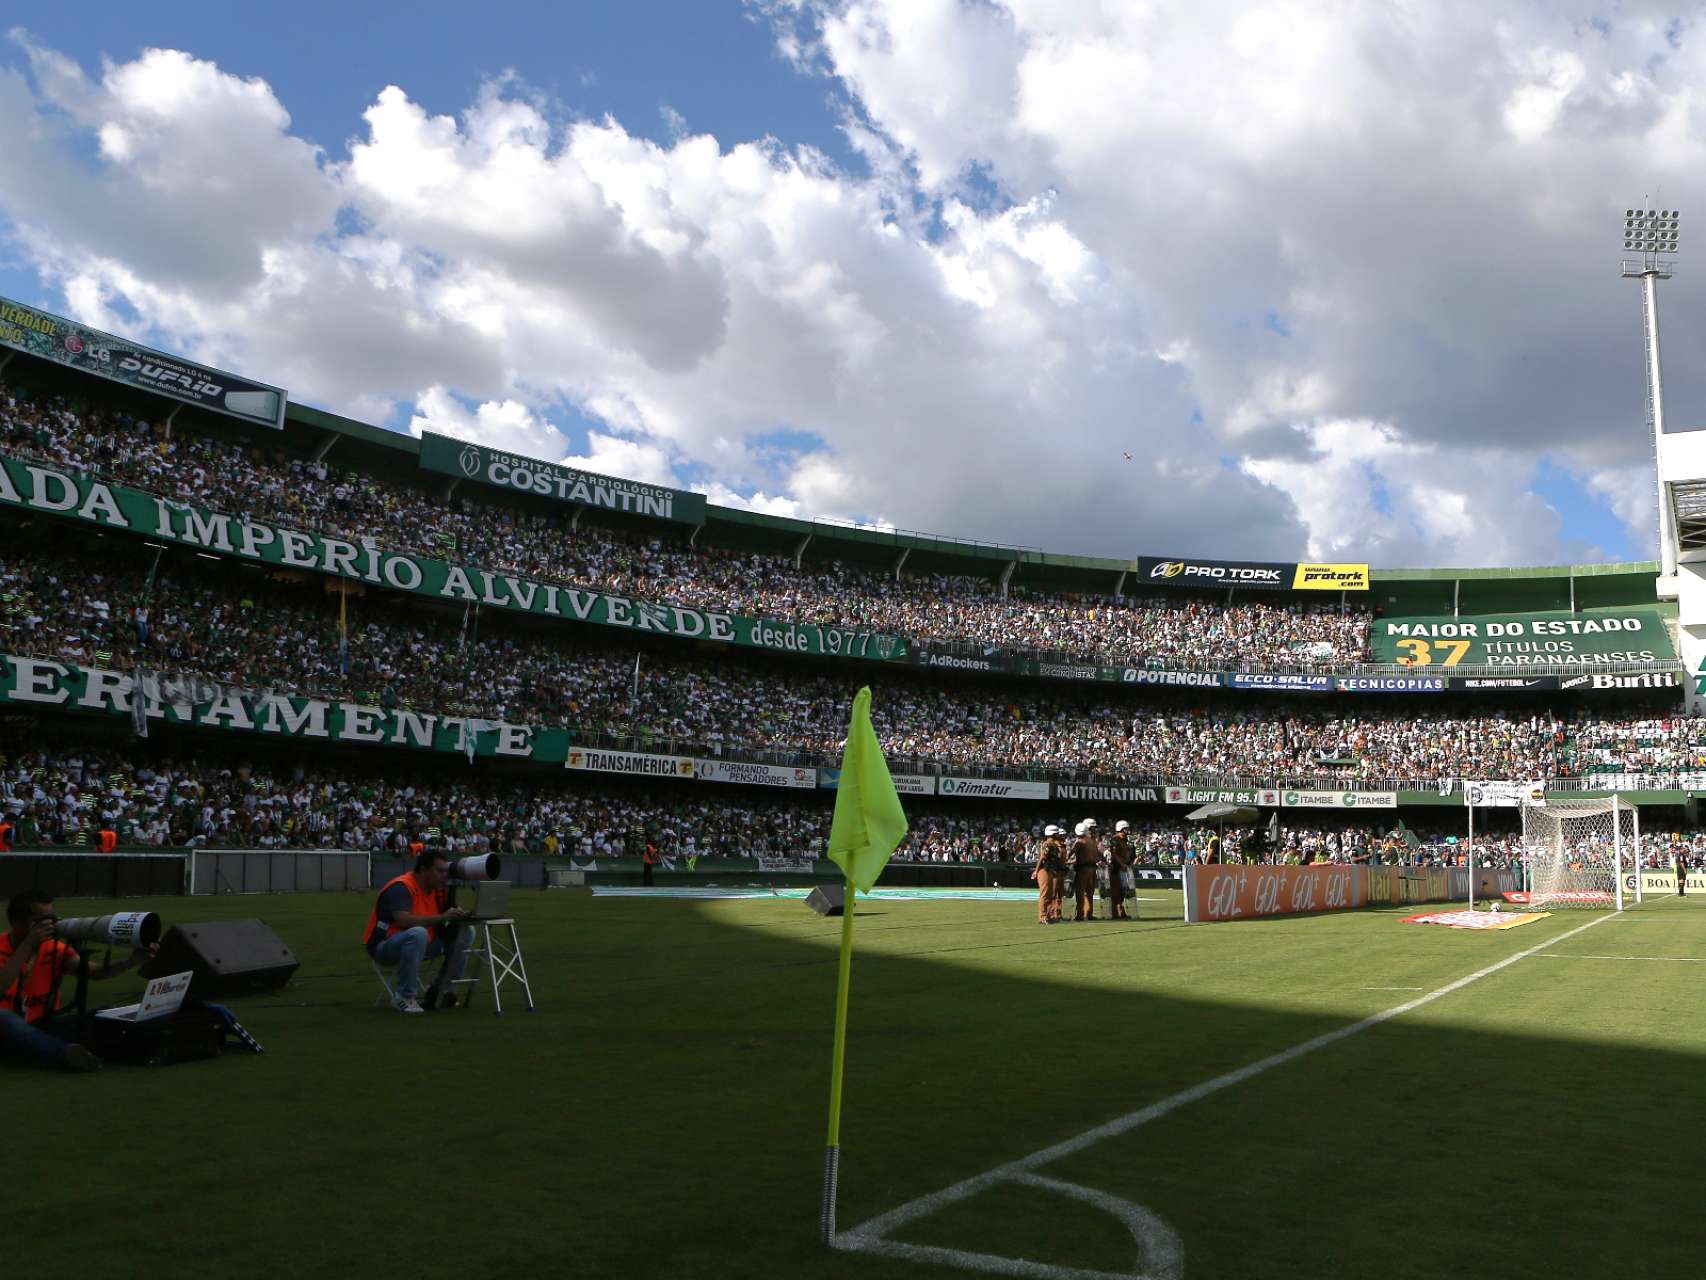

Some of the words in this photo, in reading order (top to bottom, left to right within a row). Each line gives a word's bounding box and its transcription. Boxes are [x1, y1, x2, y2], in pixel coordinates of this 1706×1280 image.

[88, 344, 110, 362] LG
[489, 452, 562, 477] HOSPITAL
[567, 471, 673, 499] CARDIOLÓGICO
[488, 462, 673, 518] COSTANTINI
[1184, 565, 1225, 577] PRO
[1228, 568, 1281, 581] TORK
[1304, 572, 1363, 582] protork
[440, 566, 736, 642] ALVIVERDE
[750, 620, 808, 651] desde
[817, 628, 871, 656] 1977
[1387, 623, 1479, 637] MAIOR
[1486, 622, 1524, 637] DO
[1531, 618, 1642, 635] ESTADO
[1396, 639, 1472, 667] 37
[1481, 640, 1574, 654] TÍTULOS
[929, 653, 991, 670] AdRockers
[1485, 650, 1656, 666] PARANAENSES
[1137, 670, 1221, 687] POTENCIAL
[1338, 678, 1443, 690] TECNICOPIAS
[1561, 675, 1590, 689] ARROZ
[1591, 672, 1675, 689] Buriti
[585, 752, 677, 775] TRANSAMÉRICA
[719, 763, 769, 775] FORMANDO
[729, 772, 788, 785] PENSADORES
[956, 781, 1012, 796] Rimatur
[1057, 785, 1158, 801] NUTRILATINA
[1187, 791, 1217, 802] LIGHT
[1218, 792, 1235, 803] FM
[1236, 792, 1259, 803] 95.1
[1647, 878, 1671, 888] BOA
